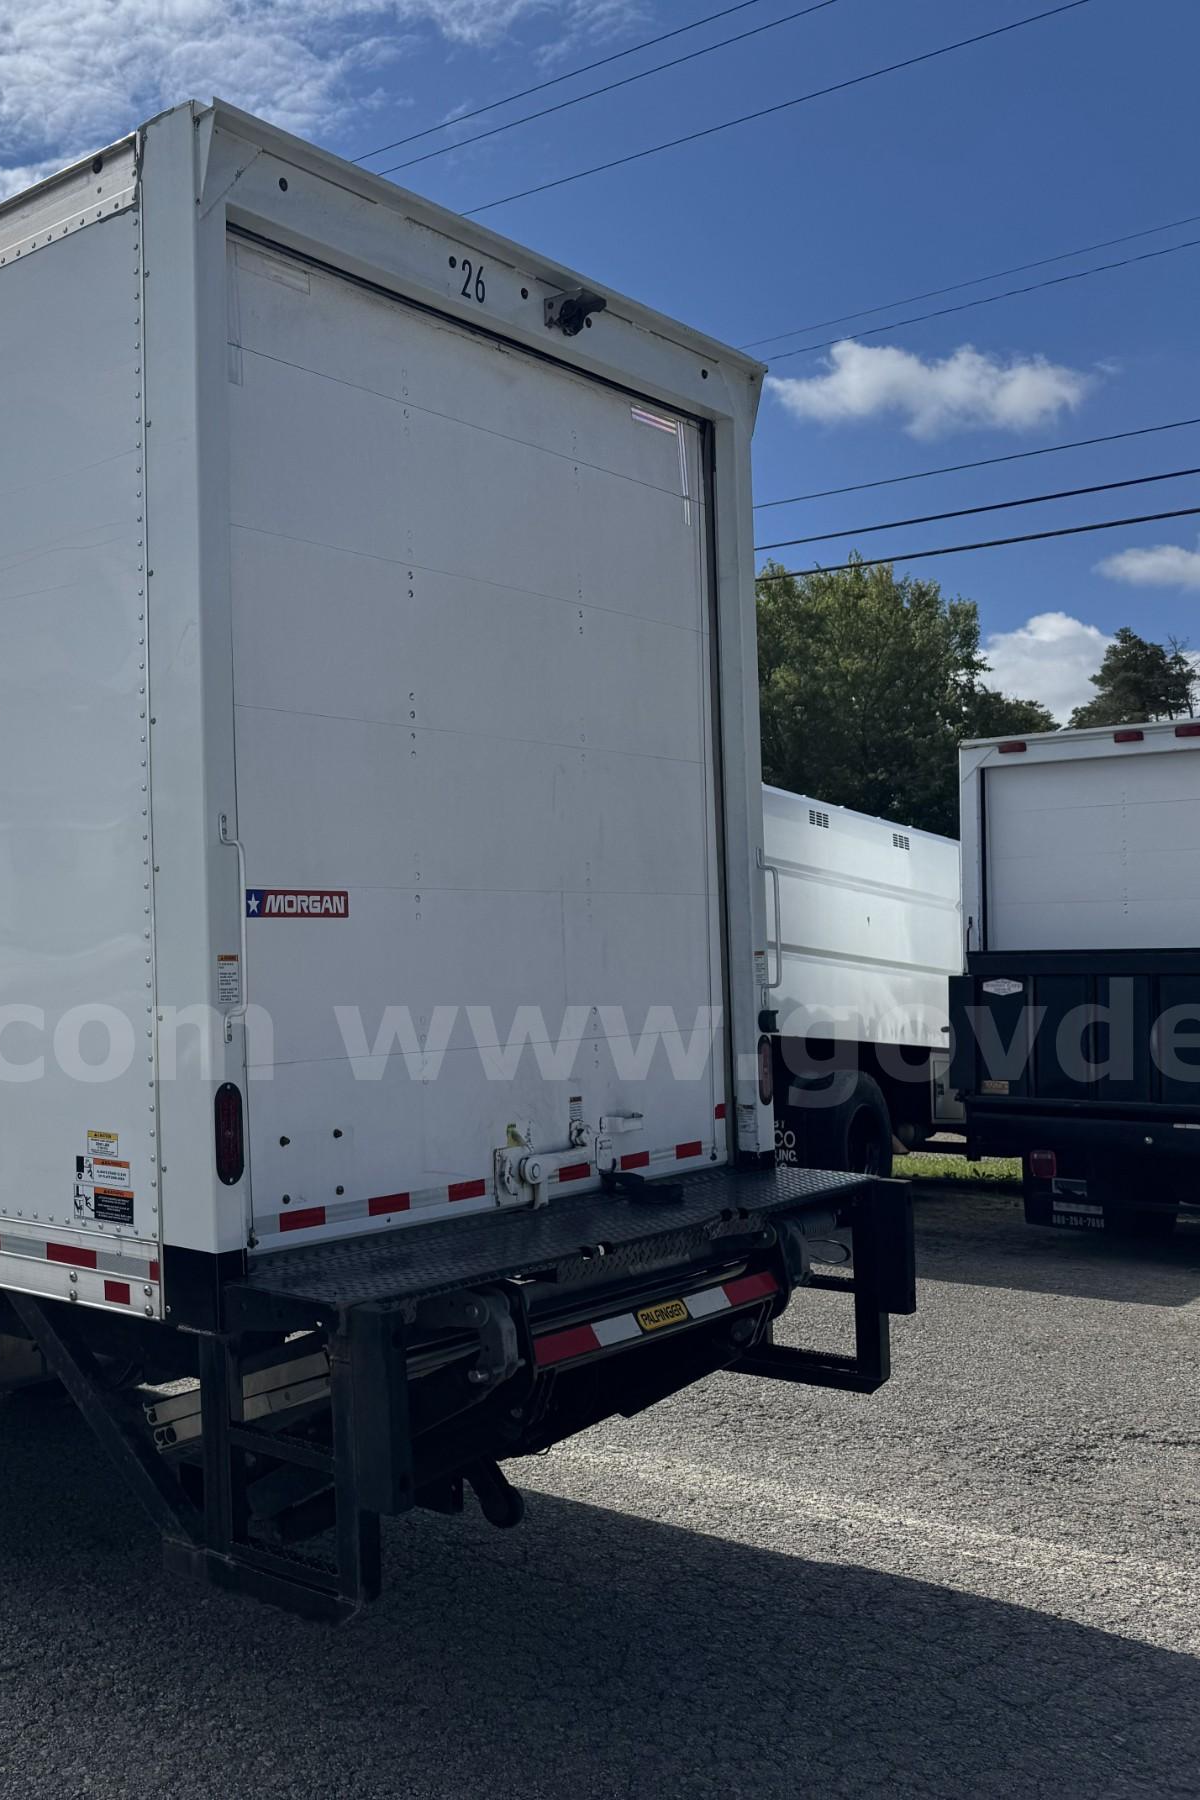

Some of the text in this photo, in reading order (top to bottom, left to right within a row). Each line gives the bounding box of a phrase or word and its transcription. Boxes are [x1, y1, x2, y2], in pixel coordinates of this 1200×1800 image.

[461, 259, 486, 303] 26
[265, 894, 345, 914] MORGAN
[641, 1304, 685, 1326] PALFINGER
